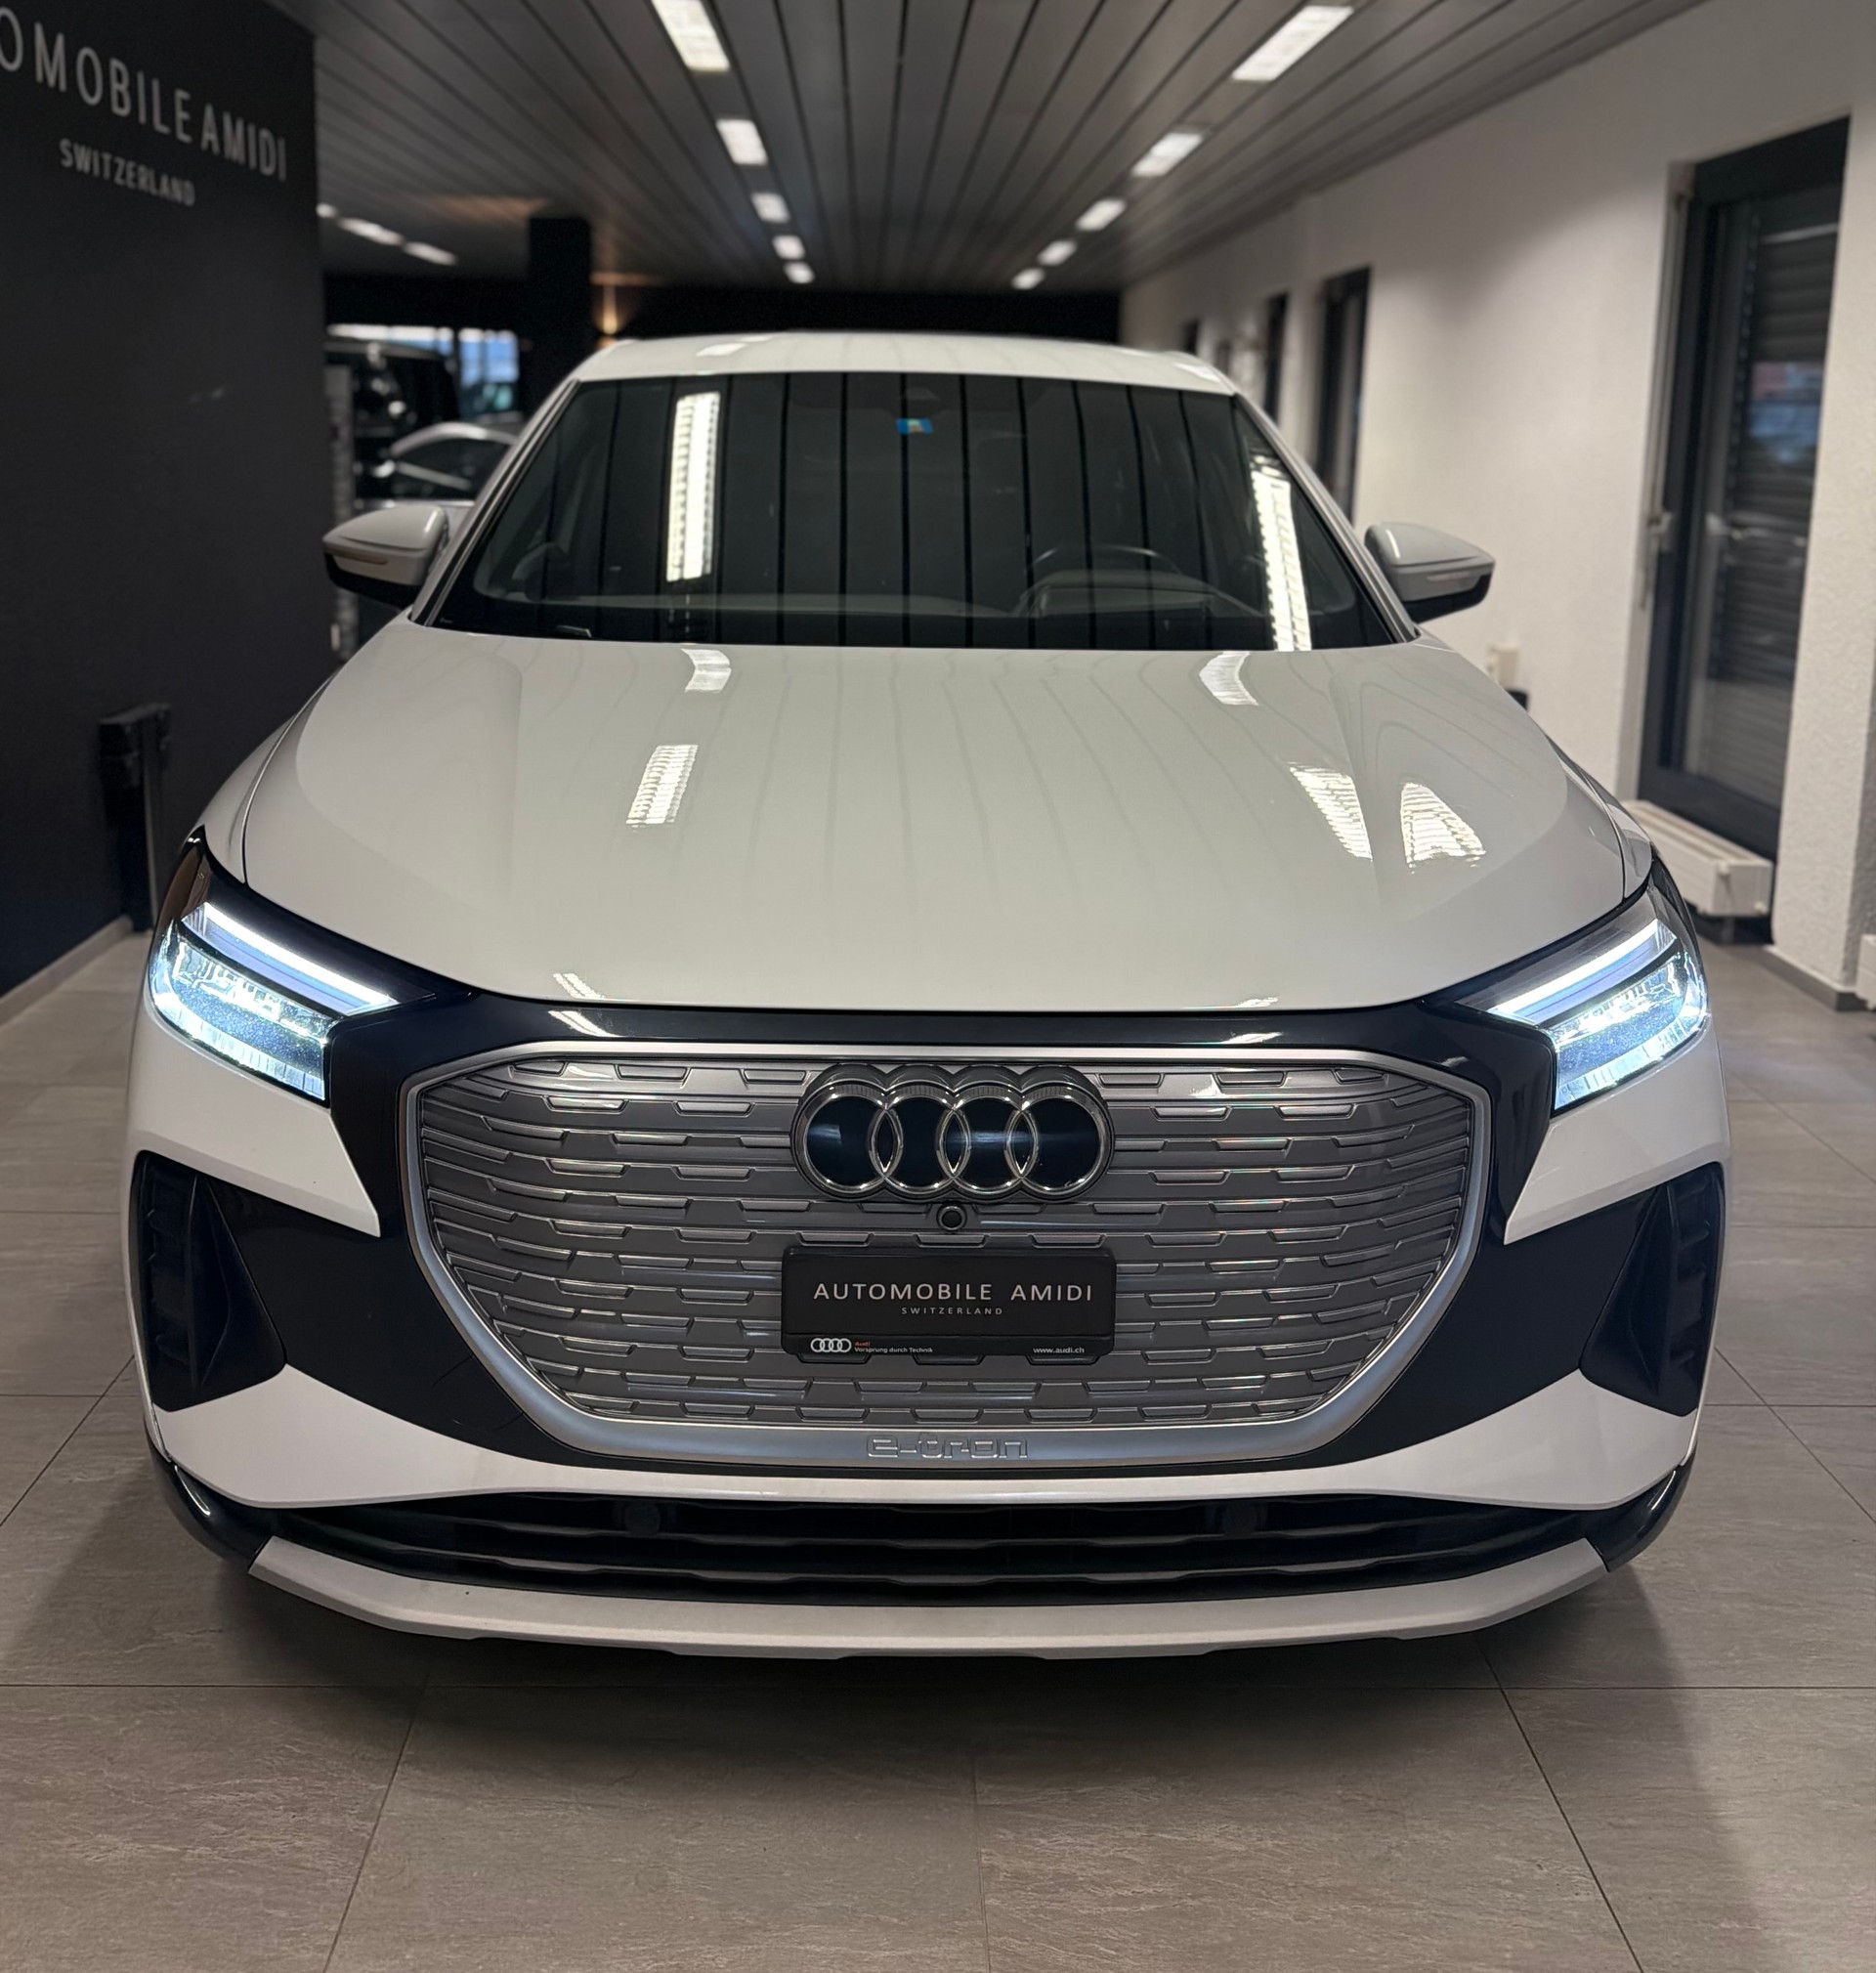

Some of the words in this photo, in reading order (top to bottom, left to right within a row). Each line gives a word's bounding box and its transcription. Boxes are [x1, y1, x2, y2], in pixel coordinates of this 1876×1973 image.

[200, 103, 286, 183] AMIDI
[59, 138, 195, 207] SWITZERLAND
[813, 1283, 993, 1301] AUTOMOBILE
[1010, 1284, 1092, 1301] AMIDI
[901, 1307, 1003, 1315] SWITZERLAND
